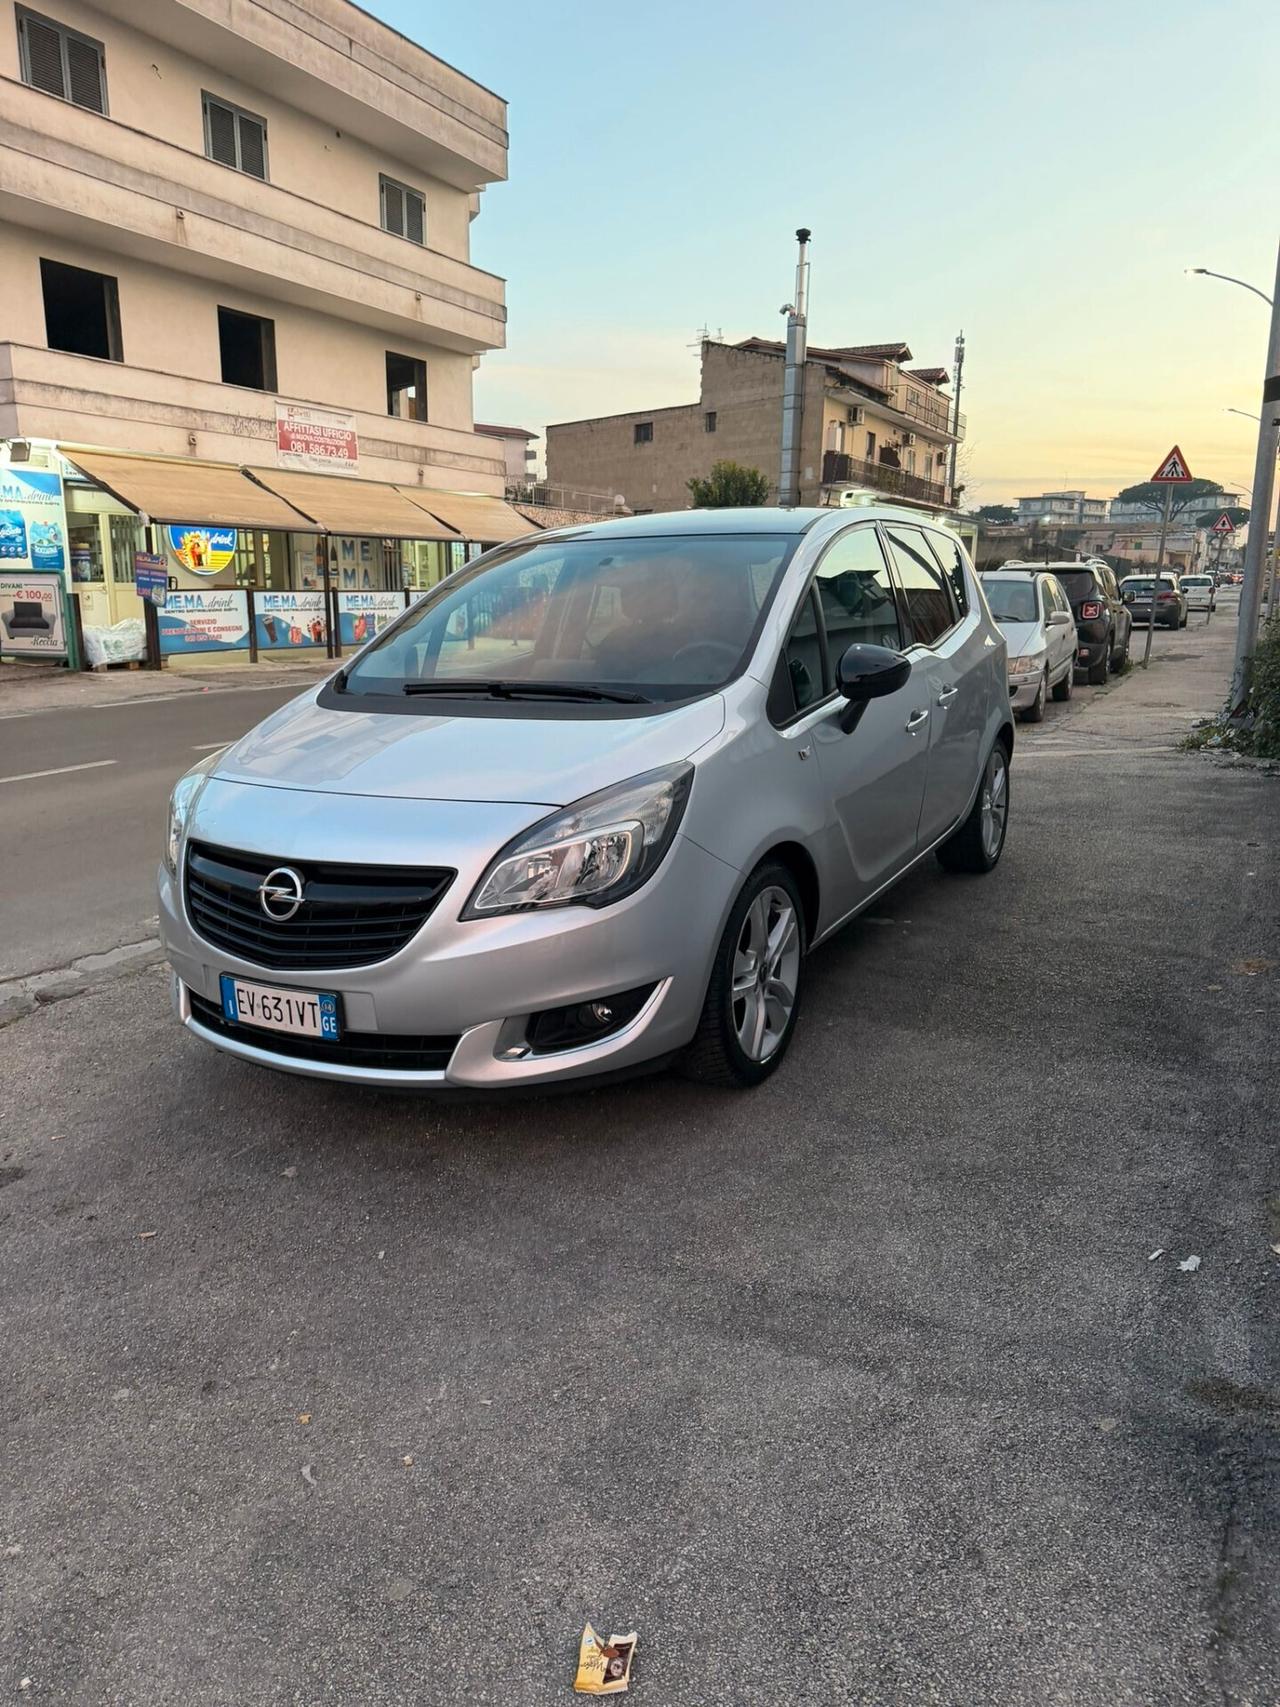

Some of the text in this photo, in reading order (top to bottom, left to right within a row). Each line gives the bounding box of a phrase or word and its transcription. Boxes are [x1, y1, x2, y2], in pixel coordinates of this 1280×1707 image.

[284, 422, 322, 436] AFFITTASI
[322, 428, 352, 441] UFFICIO
[210, 532, 233, 546] drink
[207, 593, 233, 608] drink
[301, 594, 322, 608] drink
[377, 594, 396, 607] drink
[190, 618, 217, 626] SERVIZIO
[213, 625, 243, 634] CONSEGNE
[322, 1015, 337, 1033] GE
